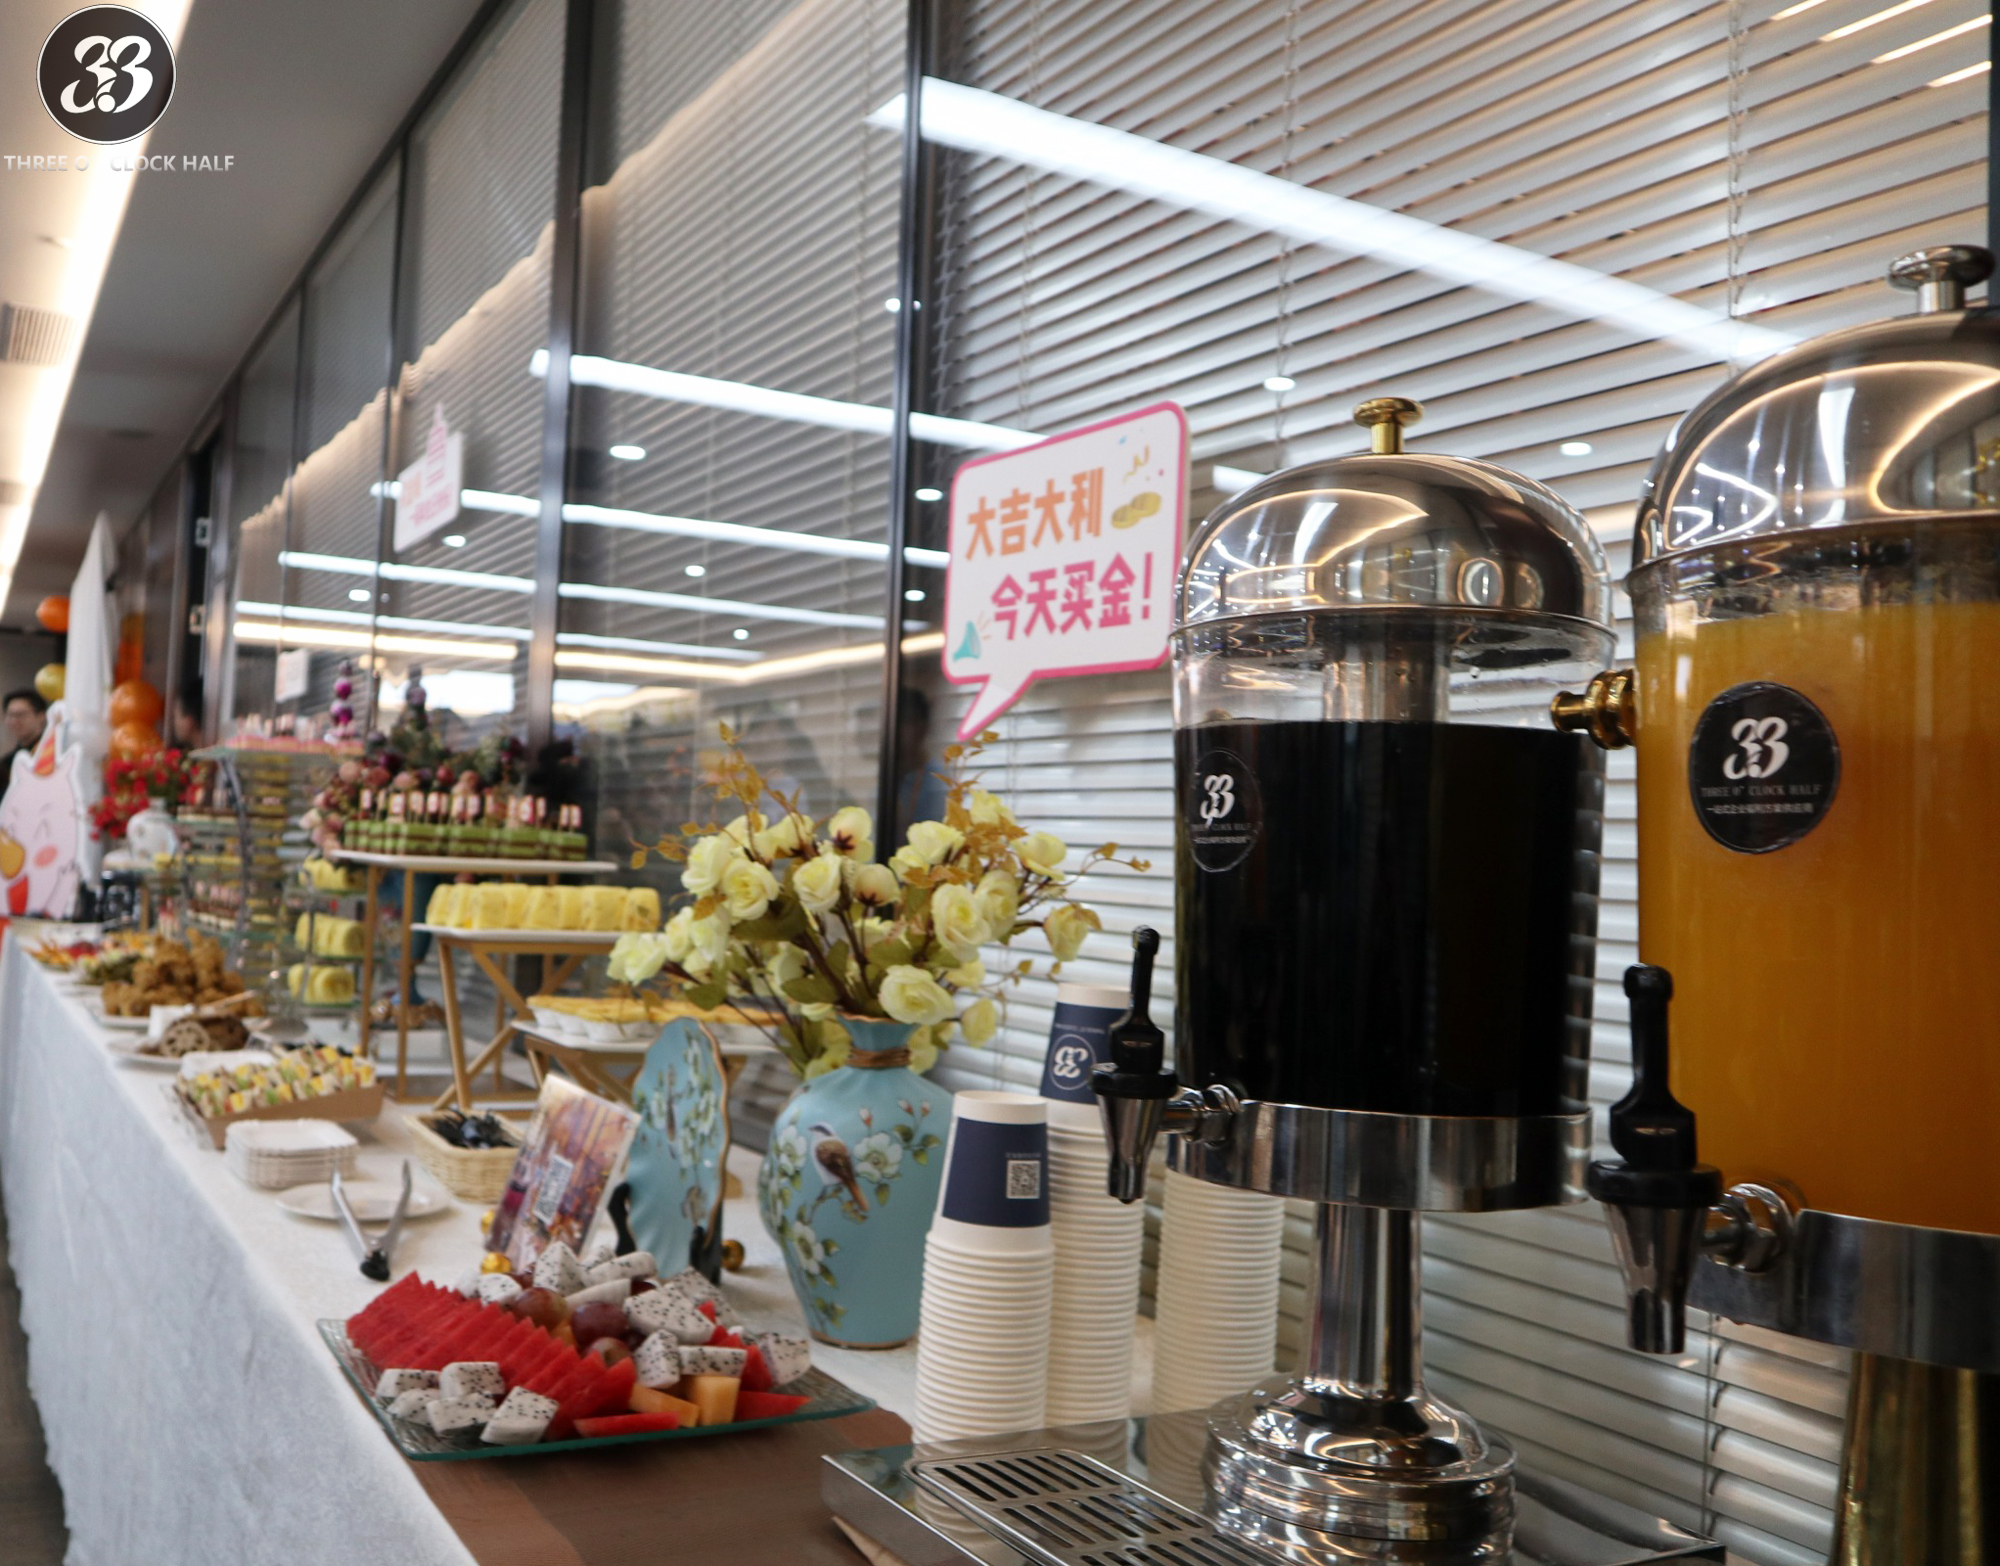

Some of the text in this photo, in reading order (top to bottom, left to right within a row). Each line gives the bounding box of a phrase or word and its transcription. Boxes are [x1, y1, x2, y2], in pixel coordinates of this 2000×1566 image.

[965, 466, 1105, 561] 大吉大利
[991, 551, 1154, 641] 今天买金!
